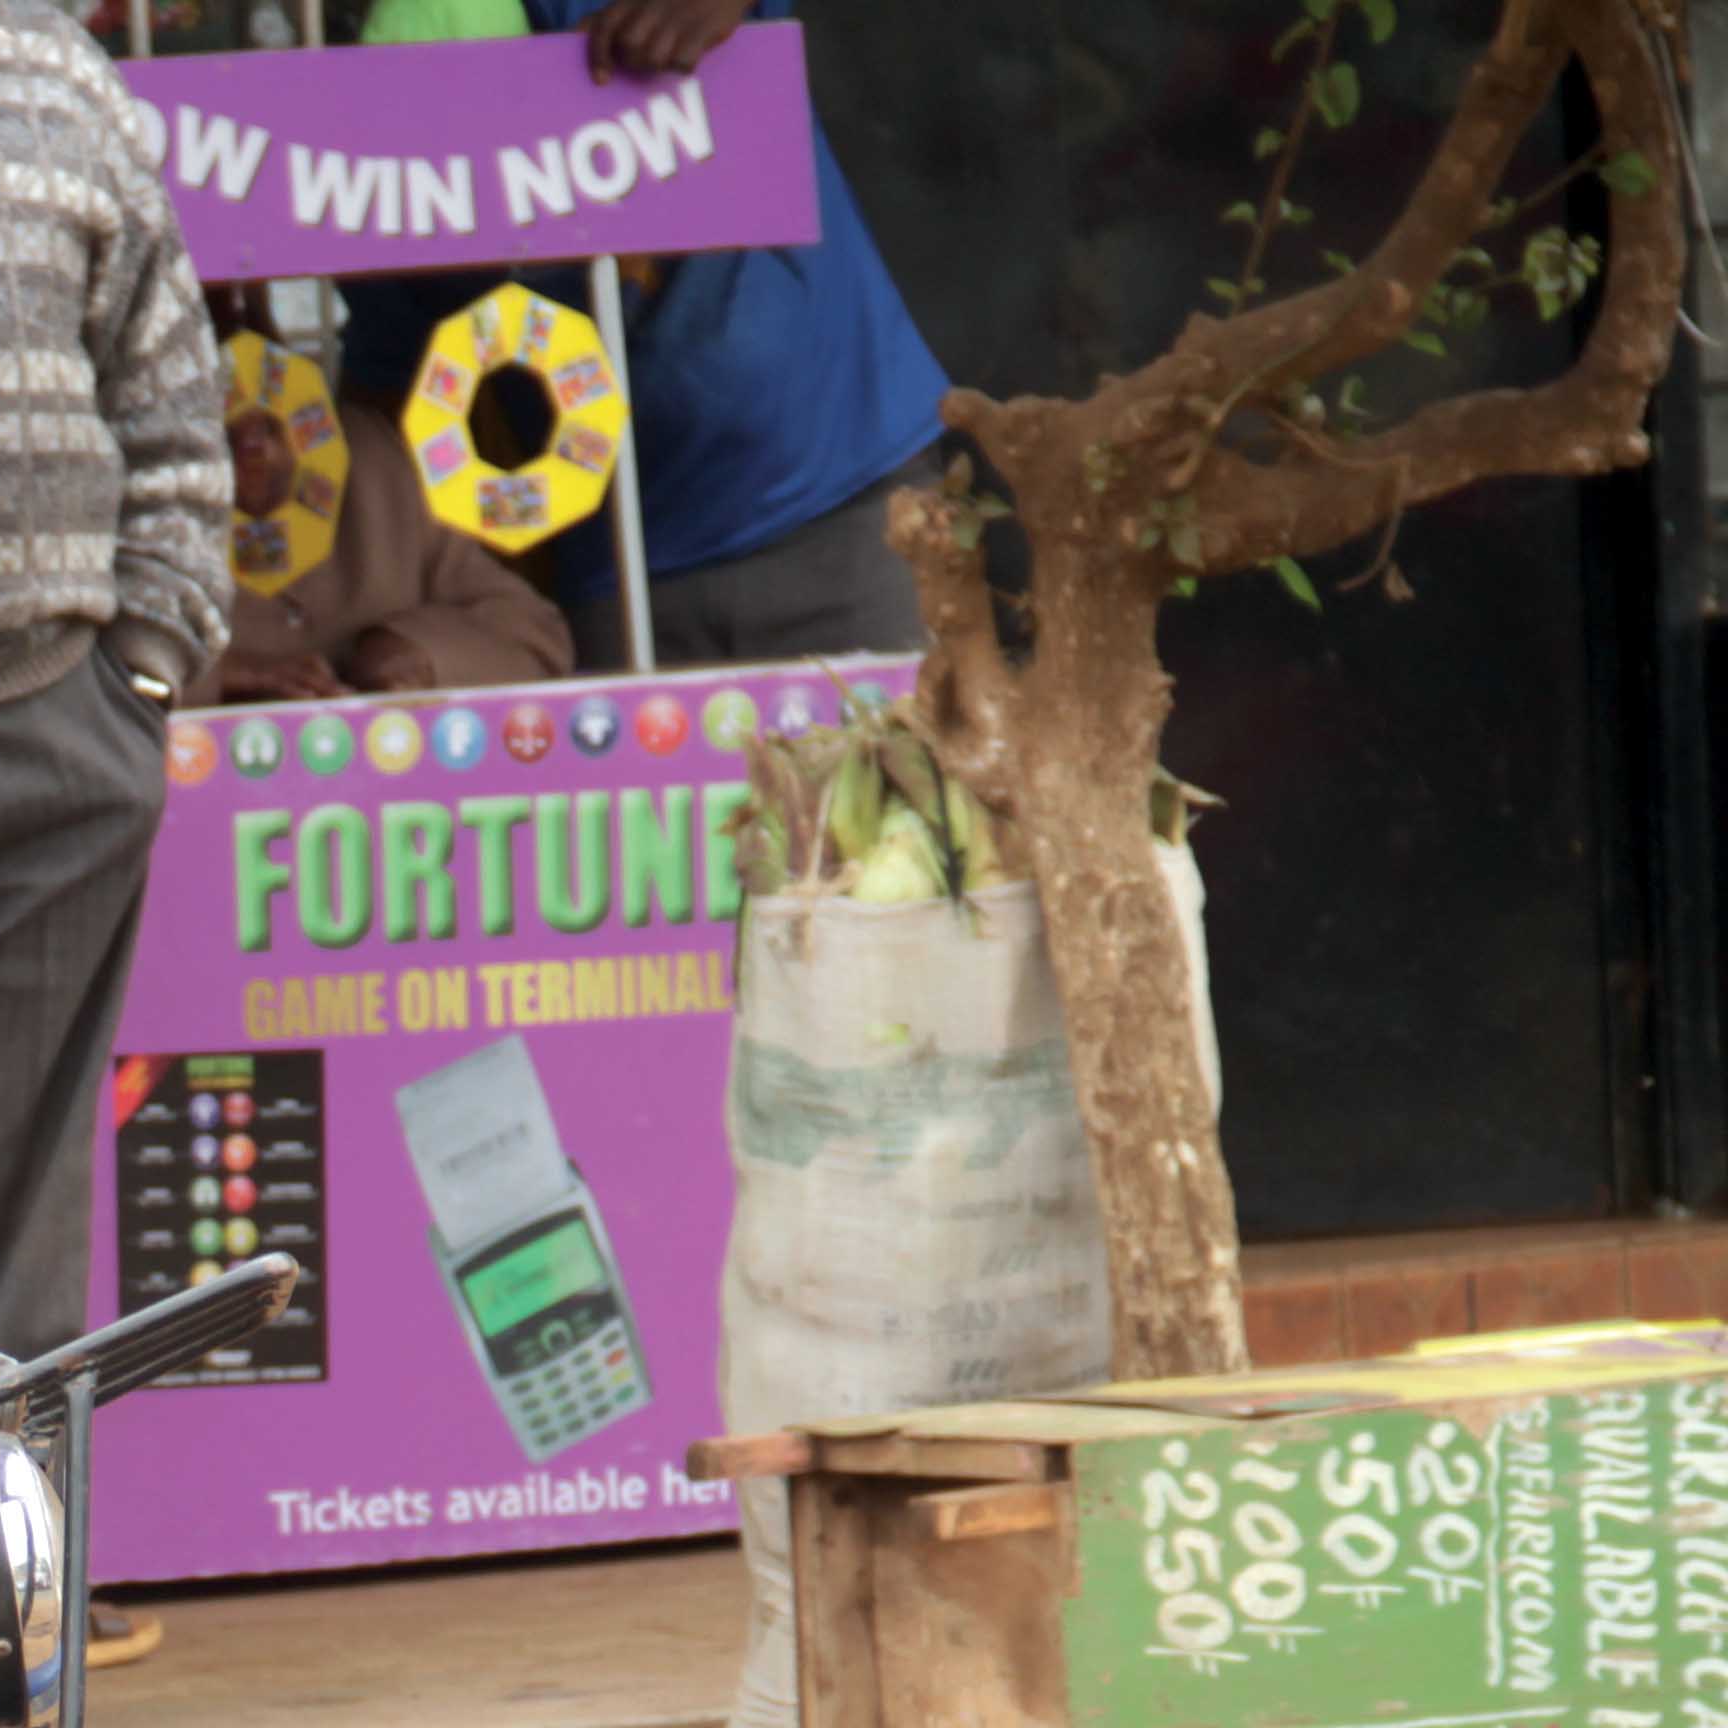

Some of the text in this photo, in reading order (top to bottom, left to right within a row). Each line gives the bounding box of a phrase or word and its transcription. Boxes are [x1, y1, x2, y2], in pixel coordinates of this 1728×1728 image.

[288, 142, 477, 237] WIN
[496, 78, 715, 226] NOW
[244, 950, 734, 1042] GAME ON TERMINAL
[268, 1484, 432, 1537] Tickets
[447, 1468, 648, 1524] available
[1506, 1397, 1555, 1693] SAFARICOM
[1580, 1391, 1659, 1687] AVAILABLE
